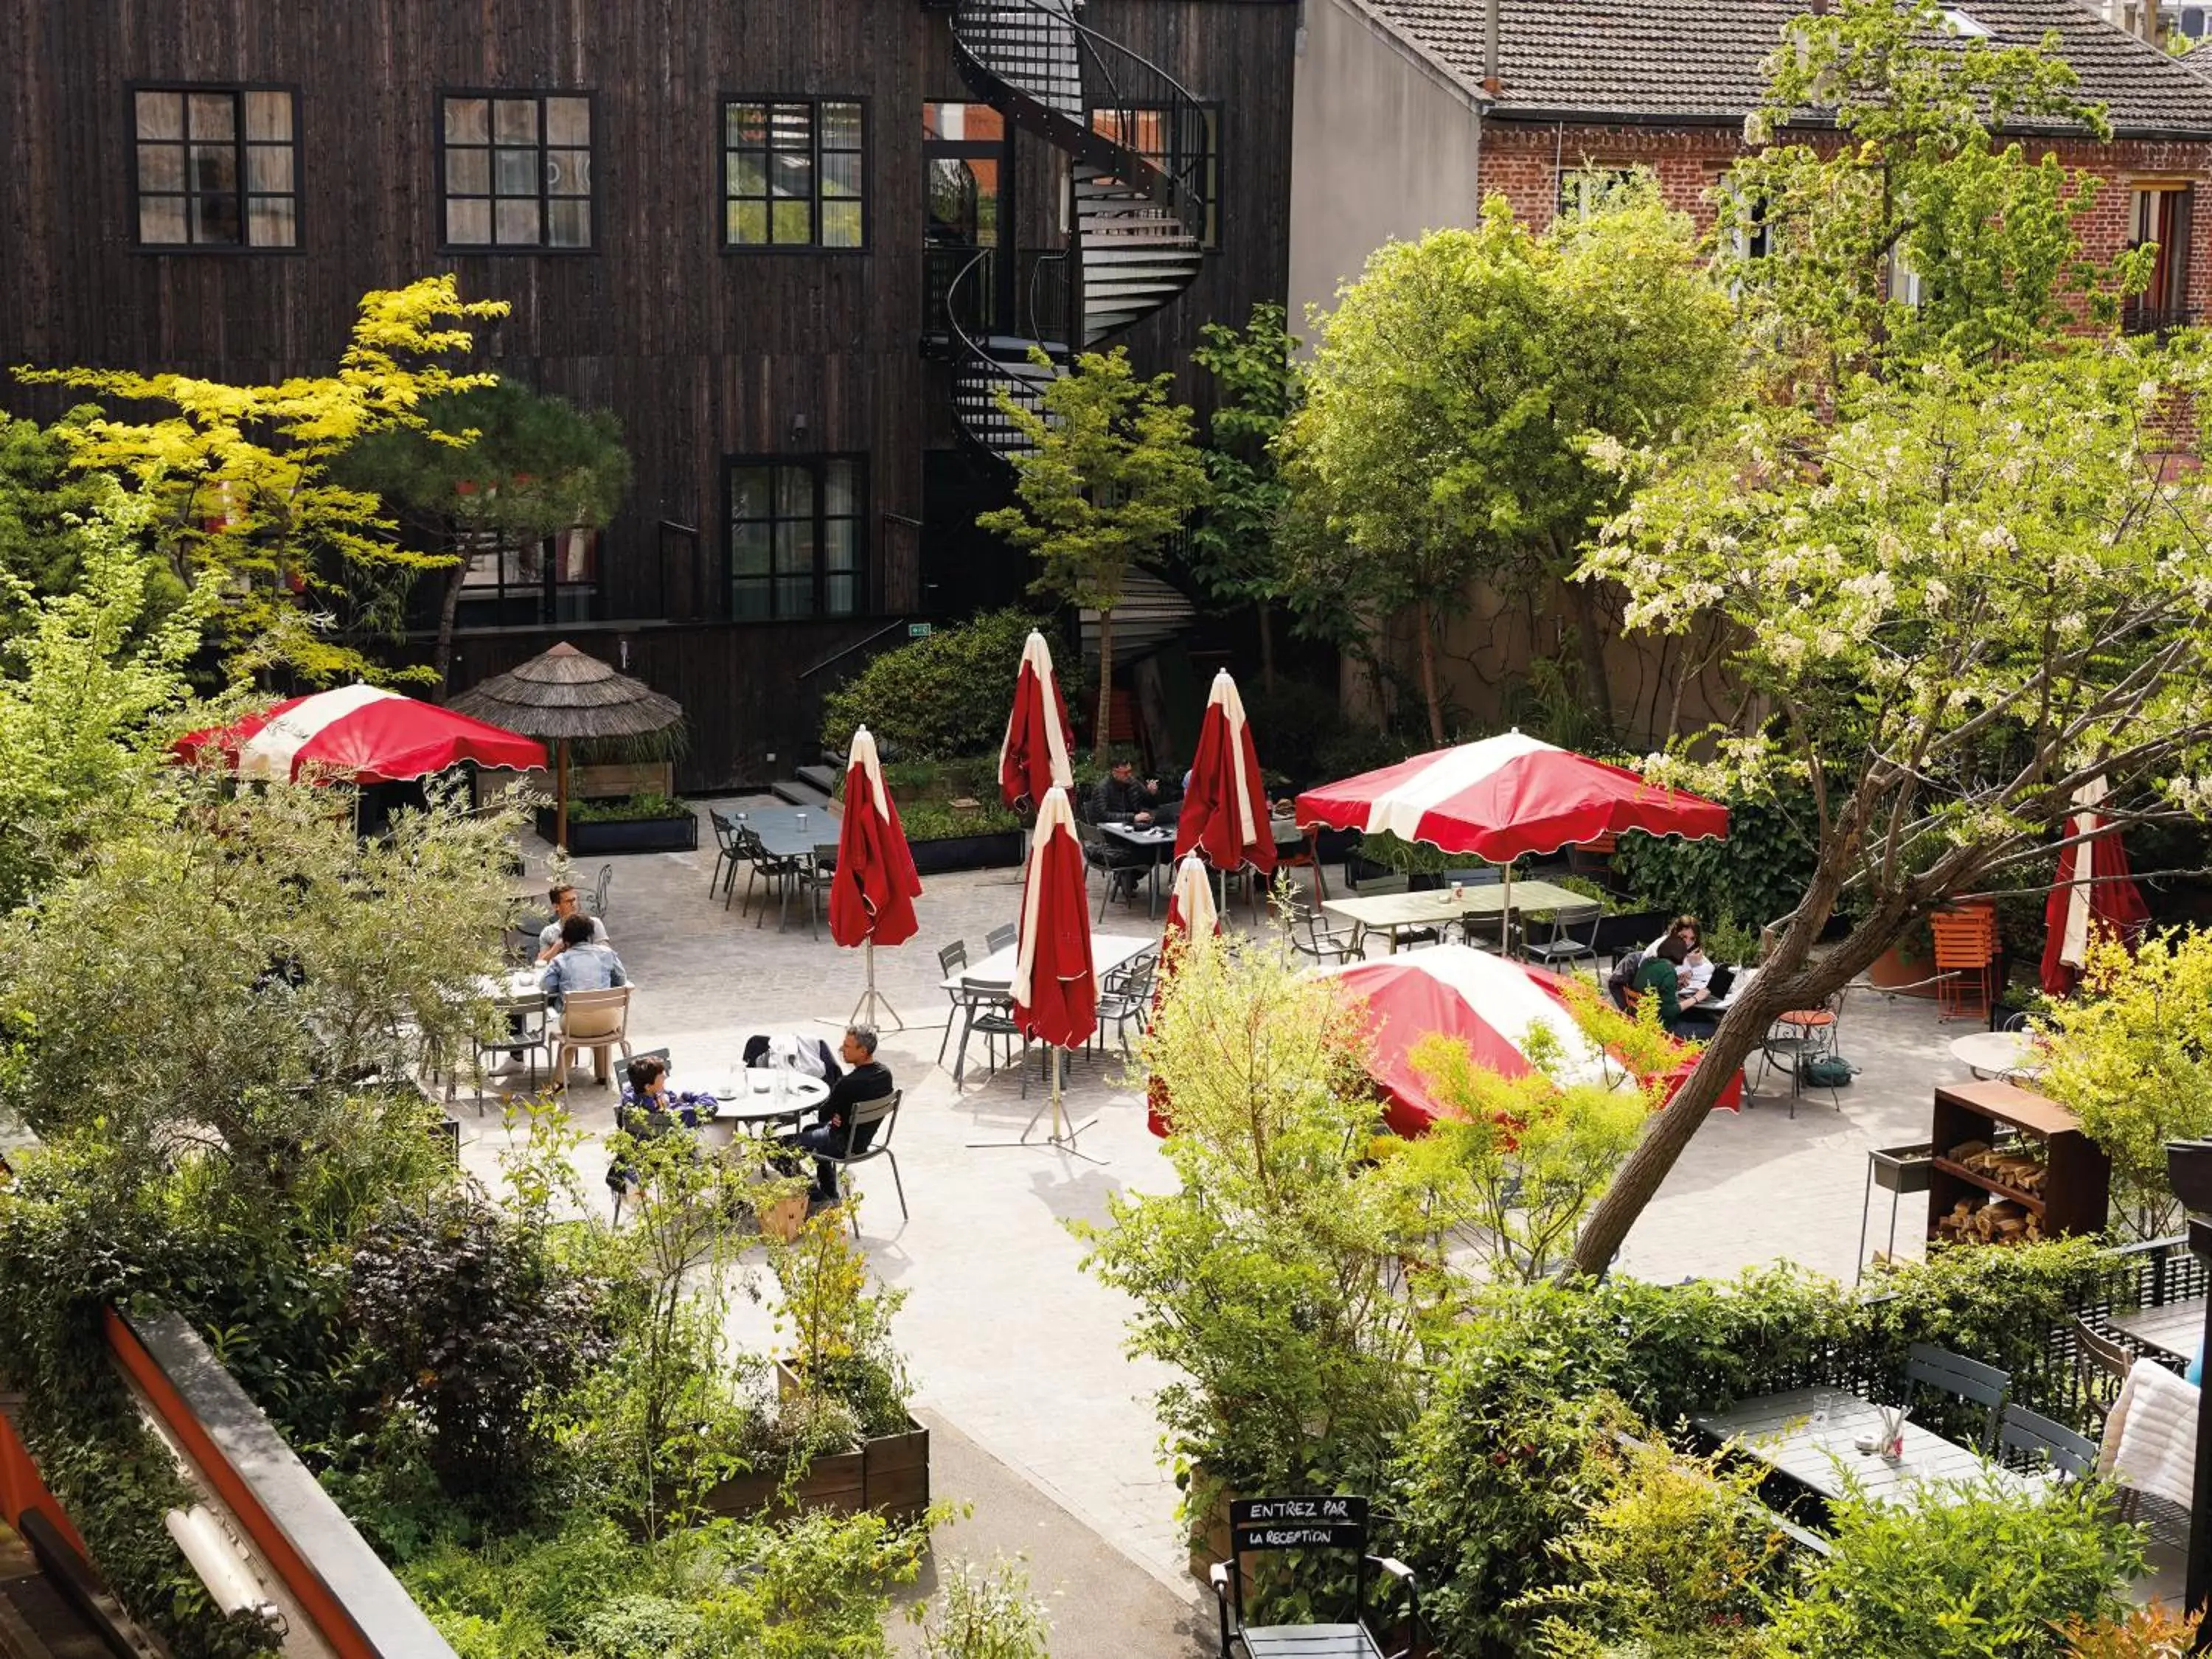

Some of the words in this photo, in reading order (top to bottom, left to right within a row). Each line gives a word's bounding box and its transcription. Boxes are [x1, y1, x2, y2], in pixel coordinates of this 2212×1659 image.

[1250, 1500, 1317, 1517] ENTREZ
[1323, 1500, 1349, 1517] PAR
[1249, 1531, 1263, 1545] LA
